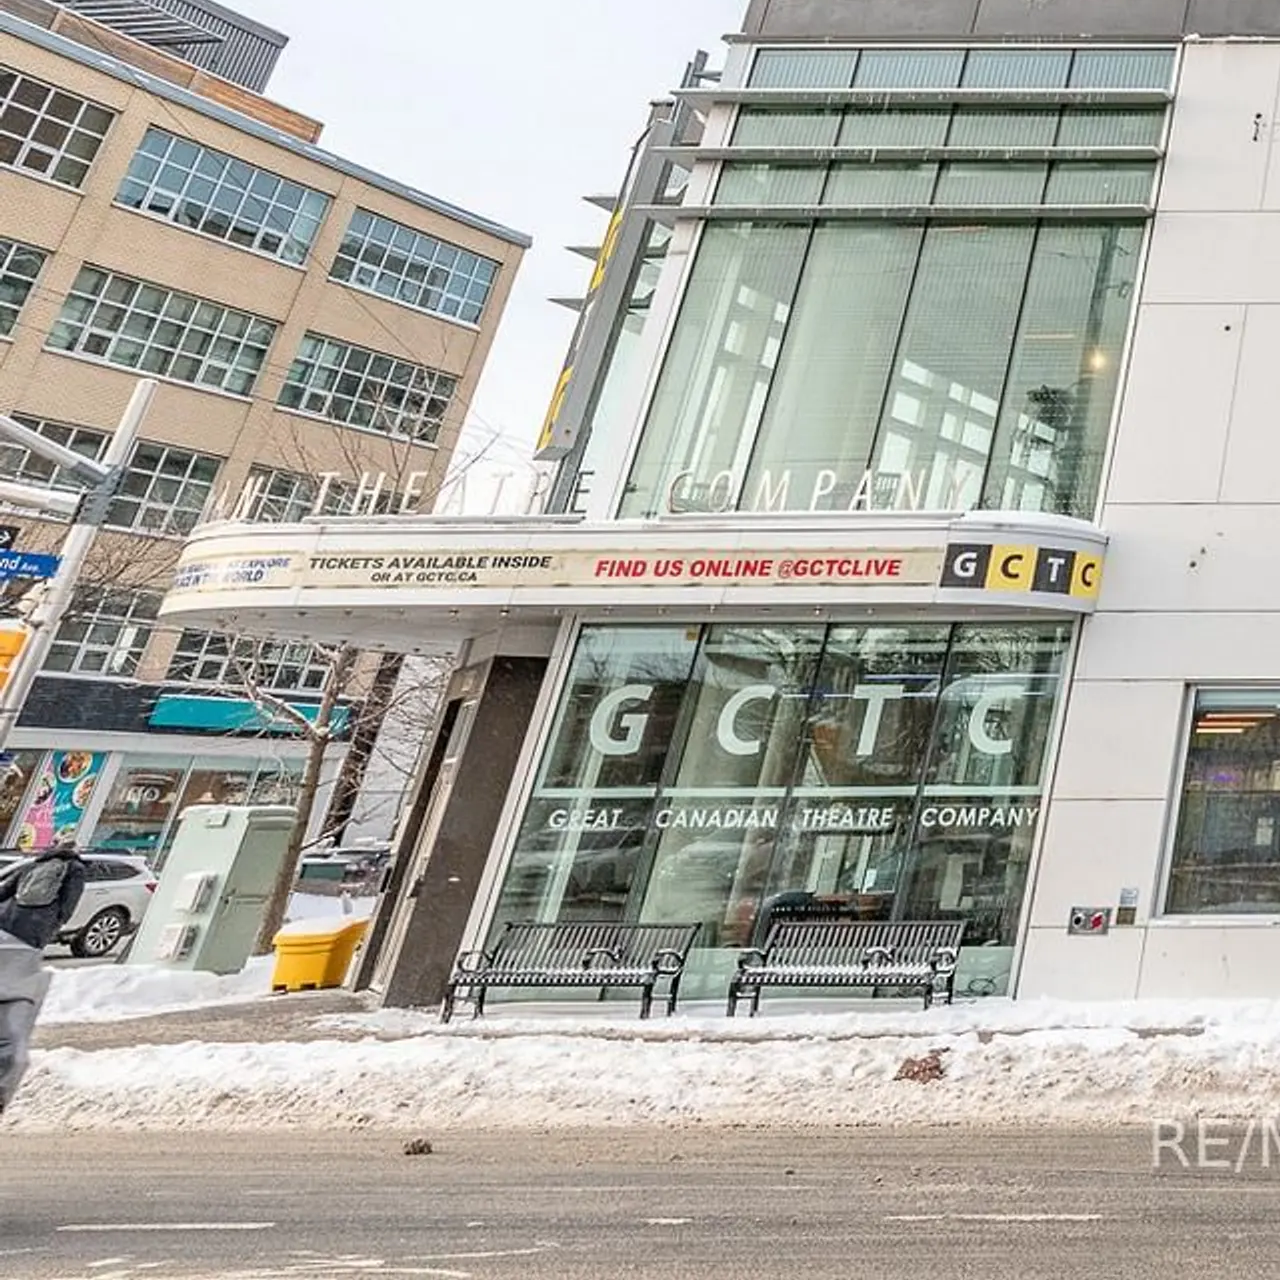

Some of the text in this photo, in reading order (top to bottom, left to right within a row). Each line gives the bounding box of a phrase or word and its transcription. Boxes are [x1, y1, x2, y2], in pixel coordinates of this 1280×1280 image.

[668, 469, 974, 511] COMPANY
[309, 555, 553, 569] TICKETS AVAILABLE INSIDE
[595, 559, 903, 579] FIND US ONLINE @GCTCLIVE
[371, 572, 391, 582] OR
[393, 572, 415, 582] AT
[549, 807, 1040, 828] GREAT CANADIAN THEATRE COMPANY
